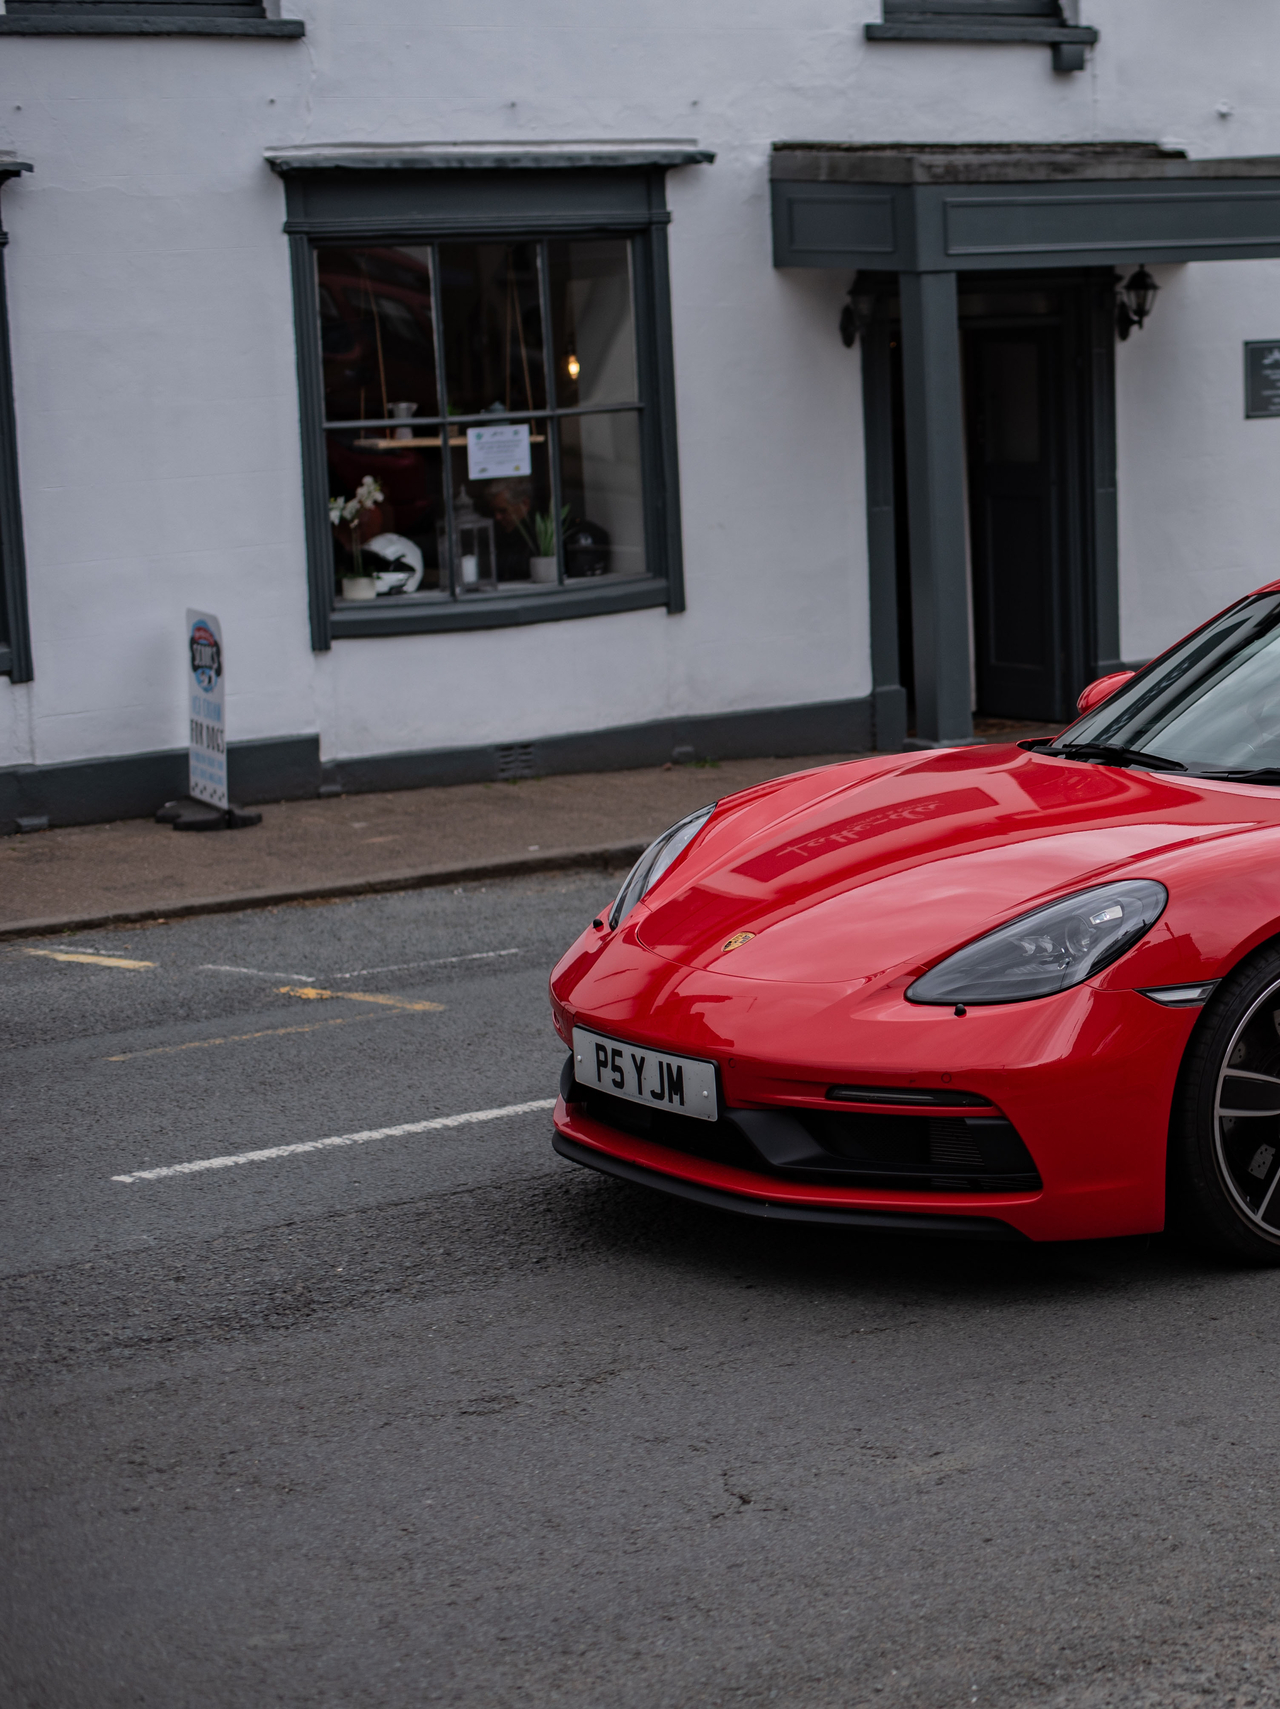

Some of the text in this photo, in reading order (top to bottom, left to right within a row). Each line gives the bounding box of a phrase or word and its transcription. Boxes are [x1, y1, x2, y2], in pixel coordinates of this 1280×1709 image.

[190, 719, 225, 755] FOR DOGS
[594, 1042, 625, 1090] P5
